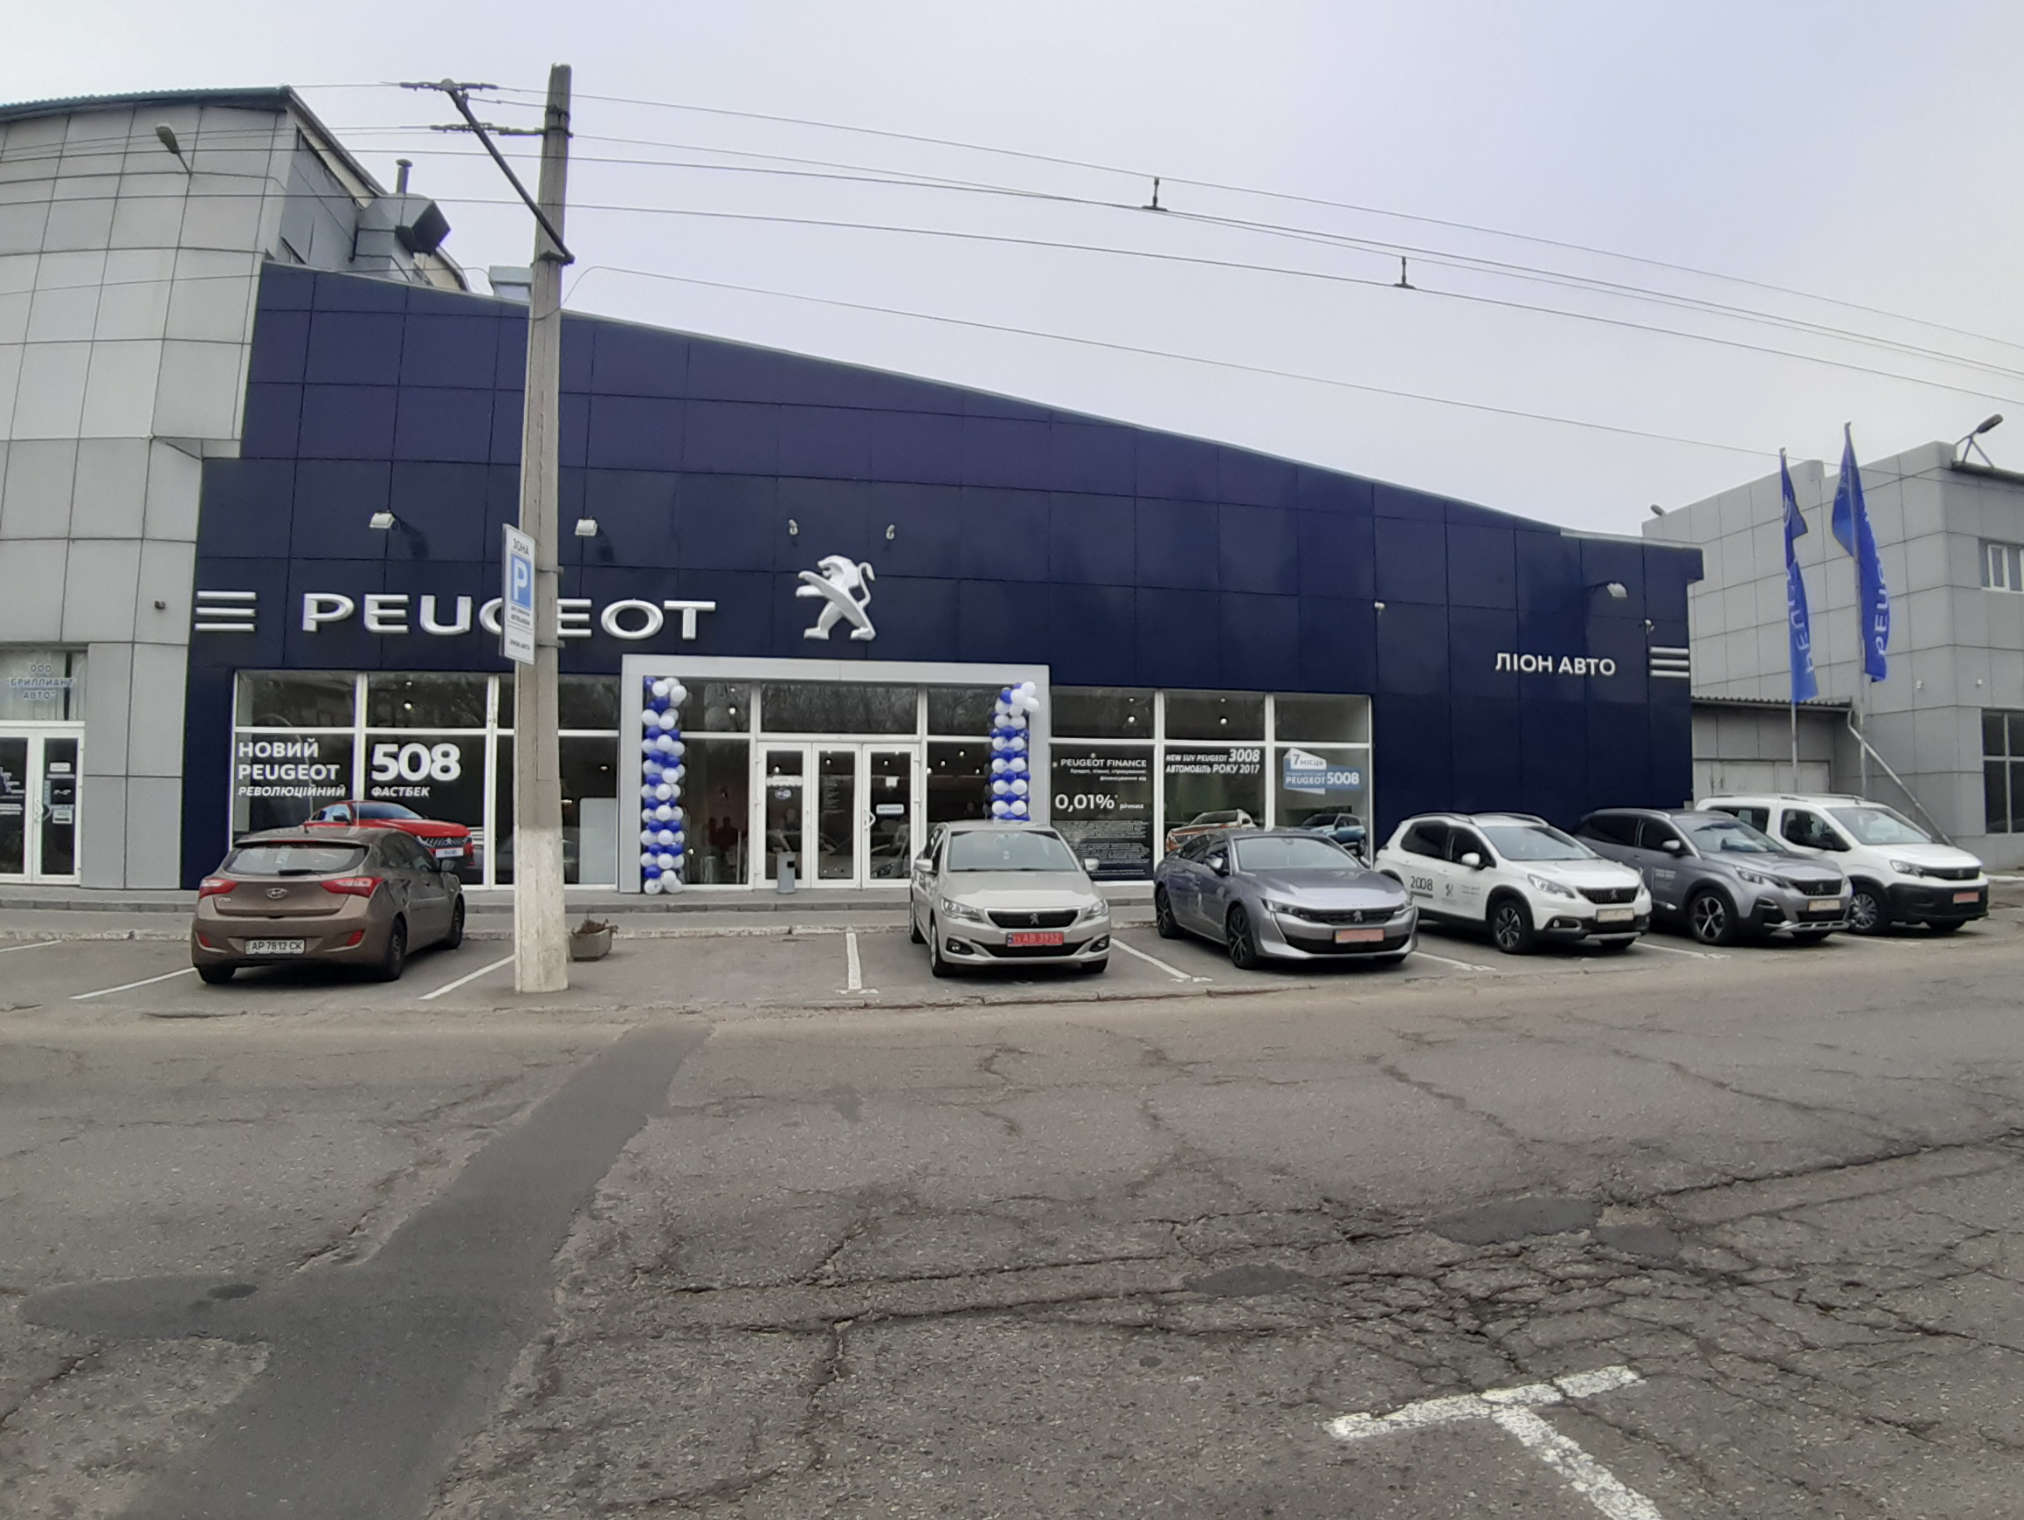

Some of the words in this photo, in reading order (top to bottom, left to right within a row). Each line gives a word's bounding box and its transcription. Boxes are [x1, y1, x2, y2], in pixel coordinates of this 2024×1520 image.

[1495, 653, 1552, 673] ЛІОН
[1558, 656, 1616, 676] АВТО
[239, 738, 318, 758] НОВИЙ
[371, 742, 461, 781] 508
[1228, 748, 1260, 763] 3008
[1293, 754, 1301, 766] 7
[1060, 759, 1105, 768] PEUGEOT
[1106, 760, 1147, 768] FINANCE
[1212, 764, 1239, 774] РОКУ
[1239, 764, 1260, 774] 2017
[238, 763, 340, 780] PEUGEOT
[1285, 776, 1326, 785] PEUGEOT
[238, 784, 347, 798] РЕВОЛЮЦІЙНИЙ
[371, 786, 431, 798] ФАСТБЕК
[1410, 875, 1433, 892] 2008
